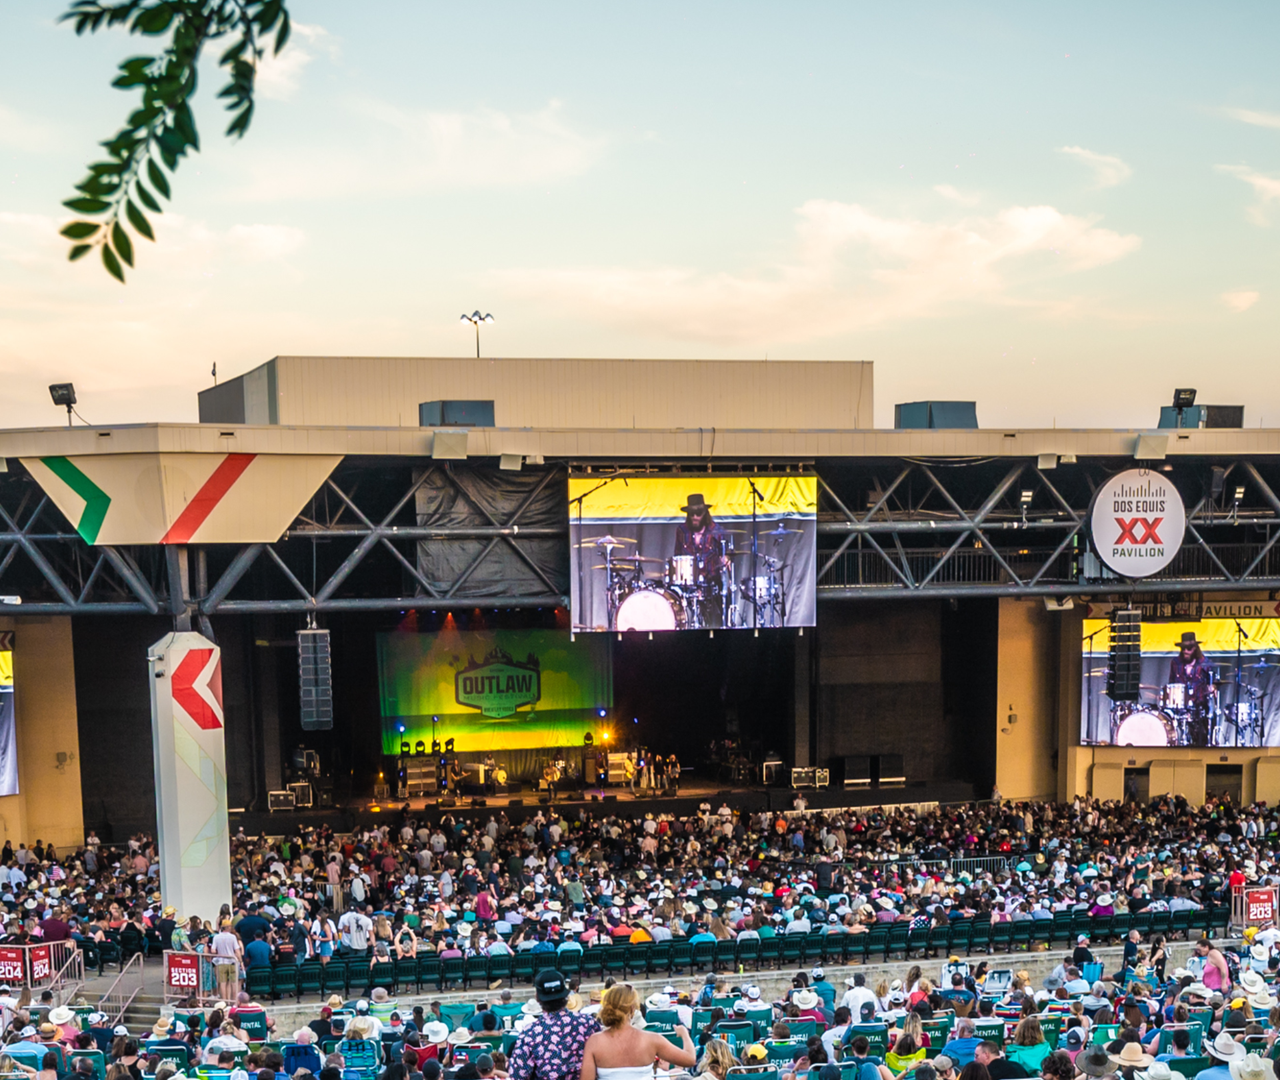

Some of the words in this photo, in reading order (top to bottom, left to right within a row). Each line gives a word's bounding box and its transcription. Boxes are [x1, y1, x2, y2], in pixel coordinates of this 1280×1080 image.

[1114, 501, 1133, 513] DOS
[1136, 500, 1166, 513] EQUIS
[1113, 517, 1165, 545] XX
[1113, 548, 1165, 558] PAVILION
[462, 674, 532, 695] OUTLAW
[1250, 907, 1272, 919] 203
[33, 964, 50, 979] 204
[171, 972, 197, 986] 203
[241, 1020, 261, 1028] RENTAL
[974, 1029, 999, 1037] RENTAL
